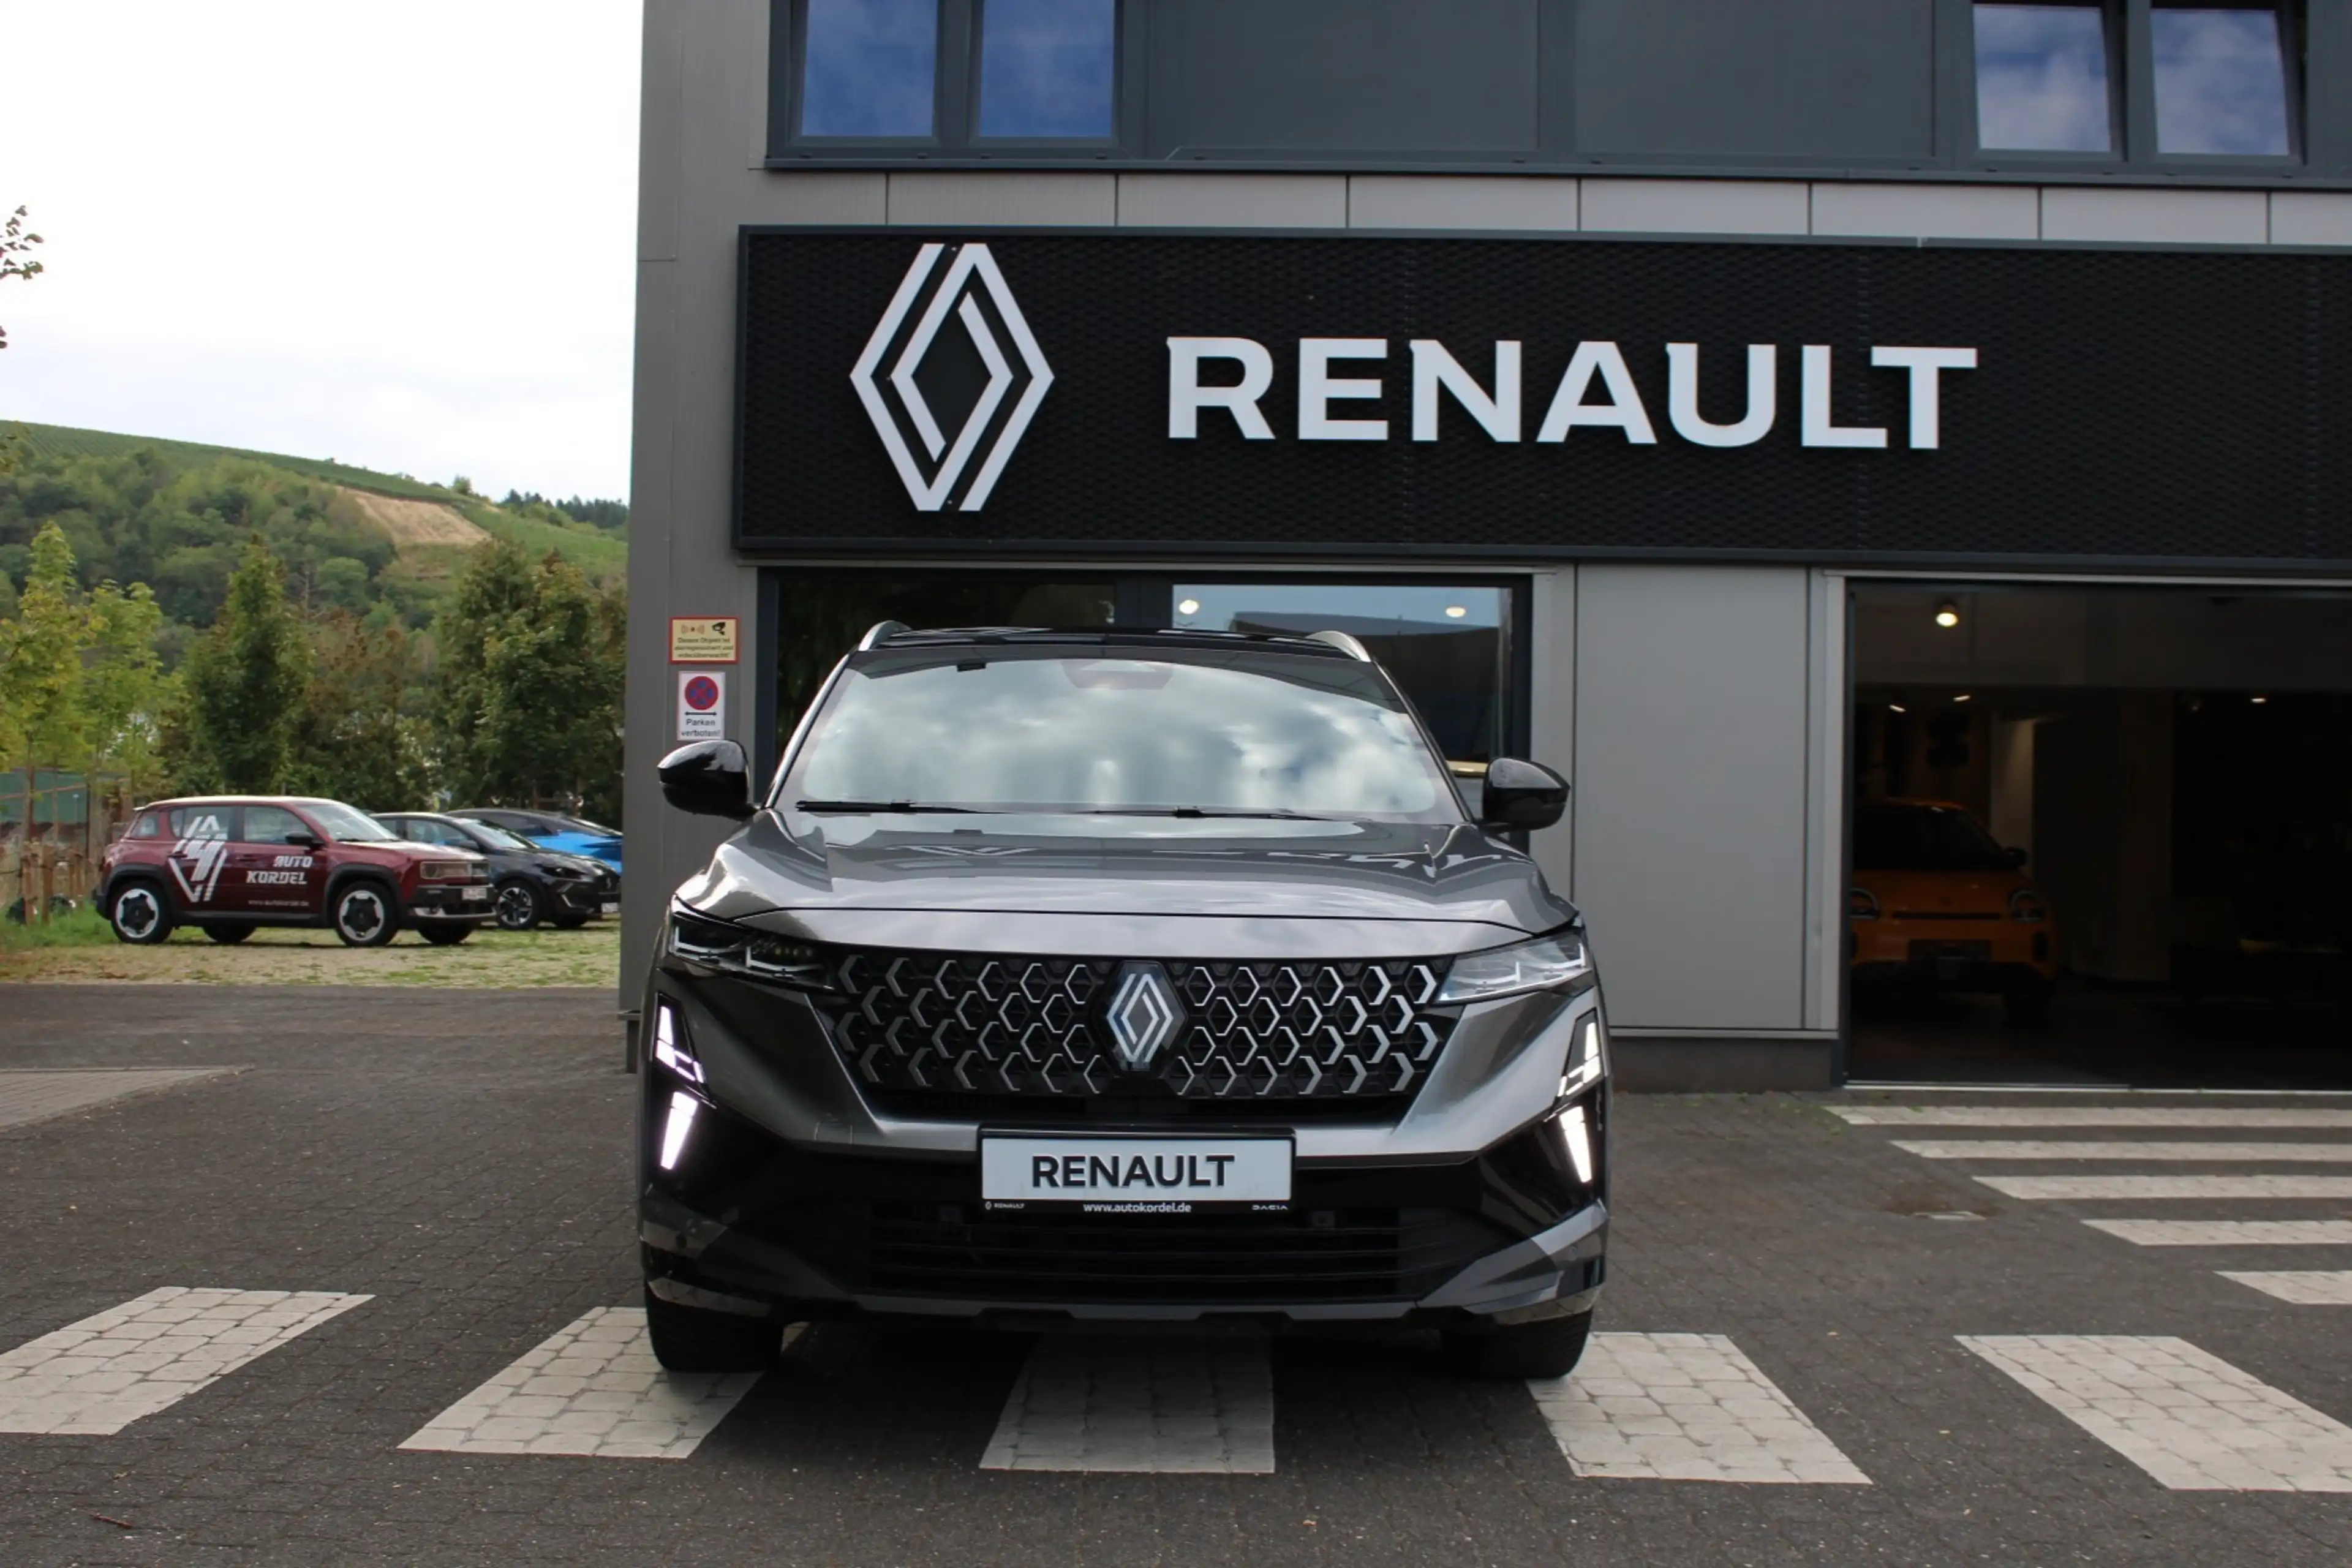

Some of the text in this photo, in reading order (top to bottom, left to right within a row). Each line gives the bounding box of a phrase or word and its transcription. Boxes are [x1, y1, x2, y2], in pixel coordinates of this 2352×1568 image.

[1166, 336, 1978, 450] RENAULT
[273, 856, 313, 867] AUTO
[246, 870, 307, 884] KORDEL
[1031, 1155, 1235, 1188] RENAULT
[1083, 1202, 1192, 1213] www.autokordel.de
